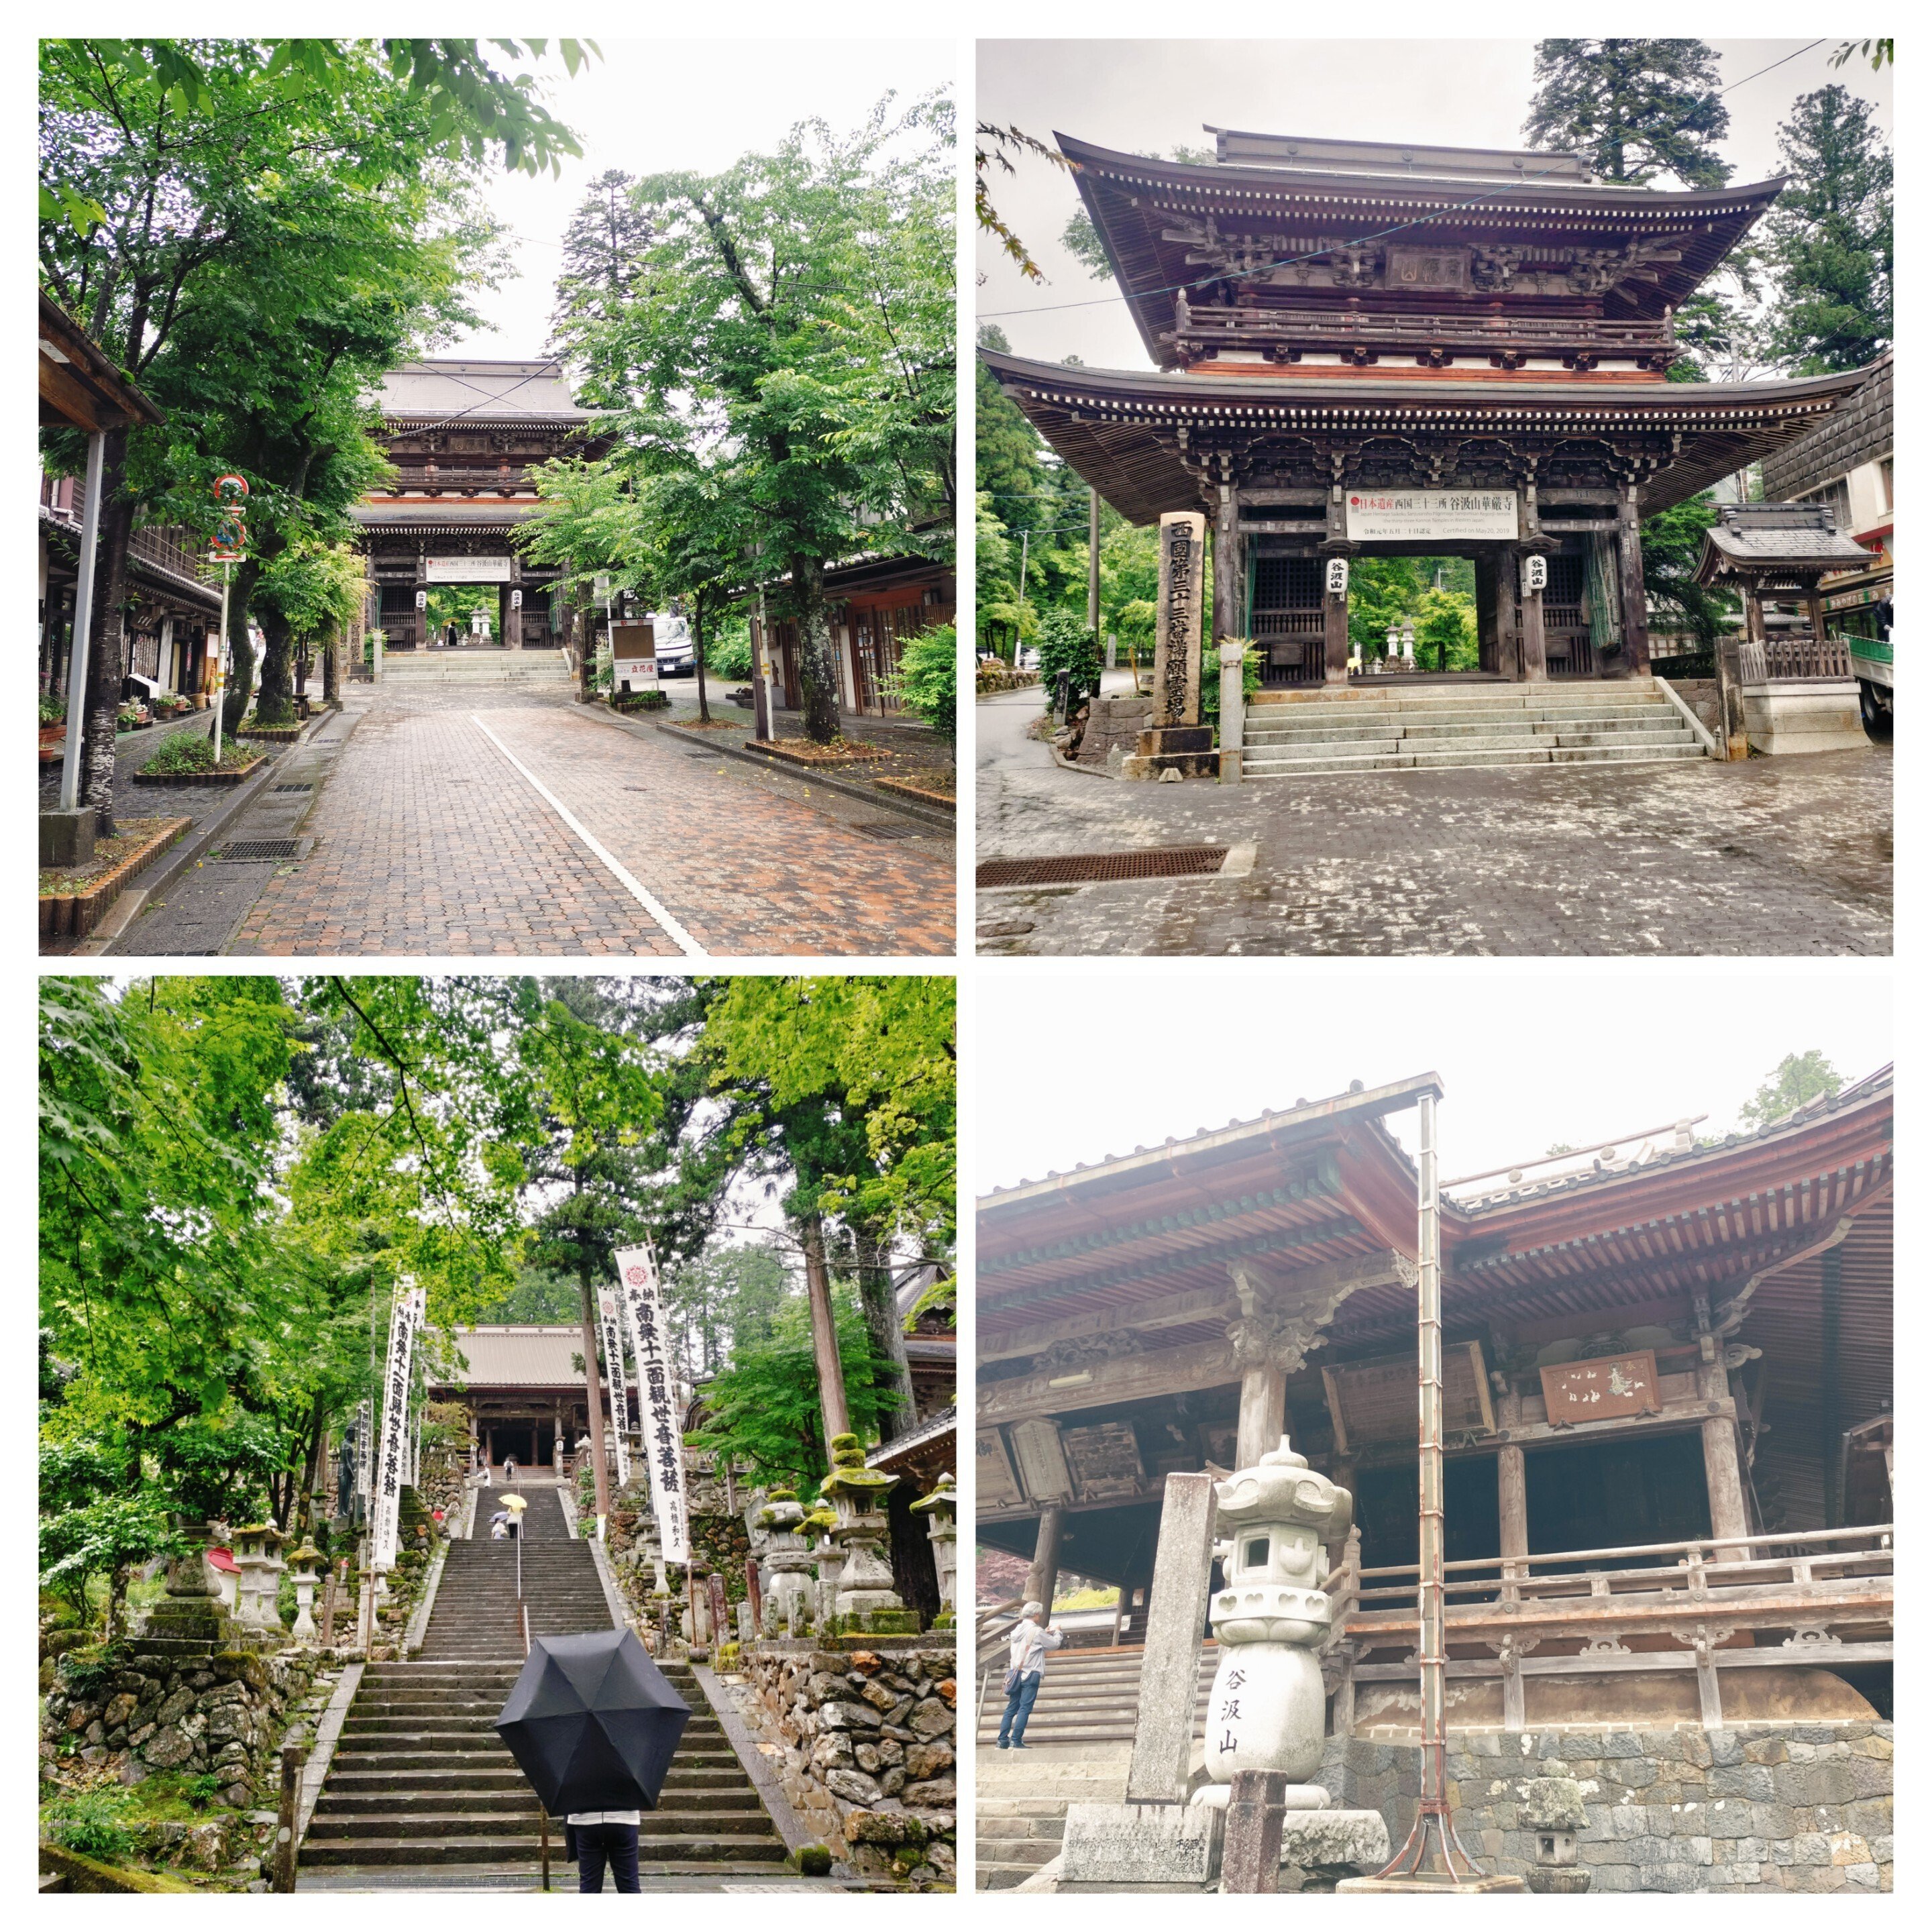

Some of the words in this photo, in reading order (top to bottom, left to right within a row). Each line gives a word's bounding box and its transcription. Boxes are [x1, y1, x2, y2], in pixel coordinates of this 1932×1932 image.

[1330, 562, 1344, 588] 谷汲山
[1532, 559, 1544, 585] 谷汲山
[631, 664, 654, 673] 立花屋
[629, 1287, 655, 1303] 奉納
[1219, 1668, 1247, 1755] 谷汲山
